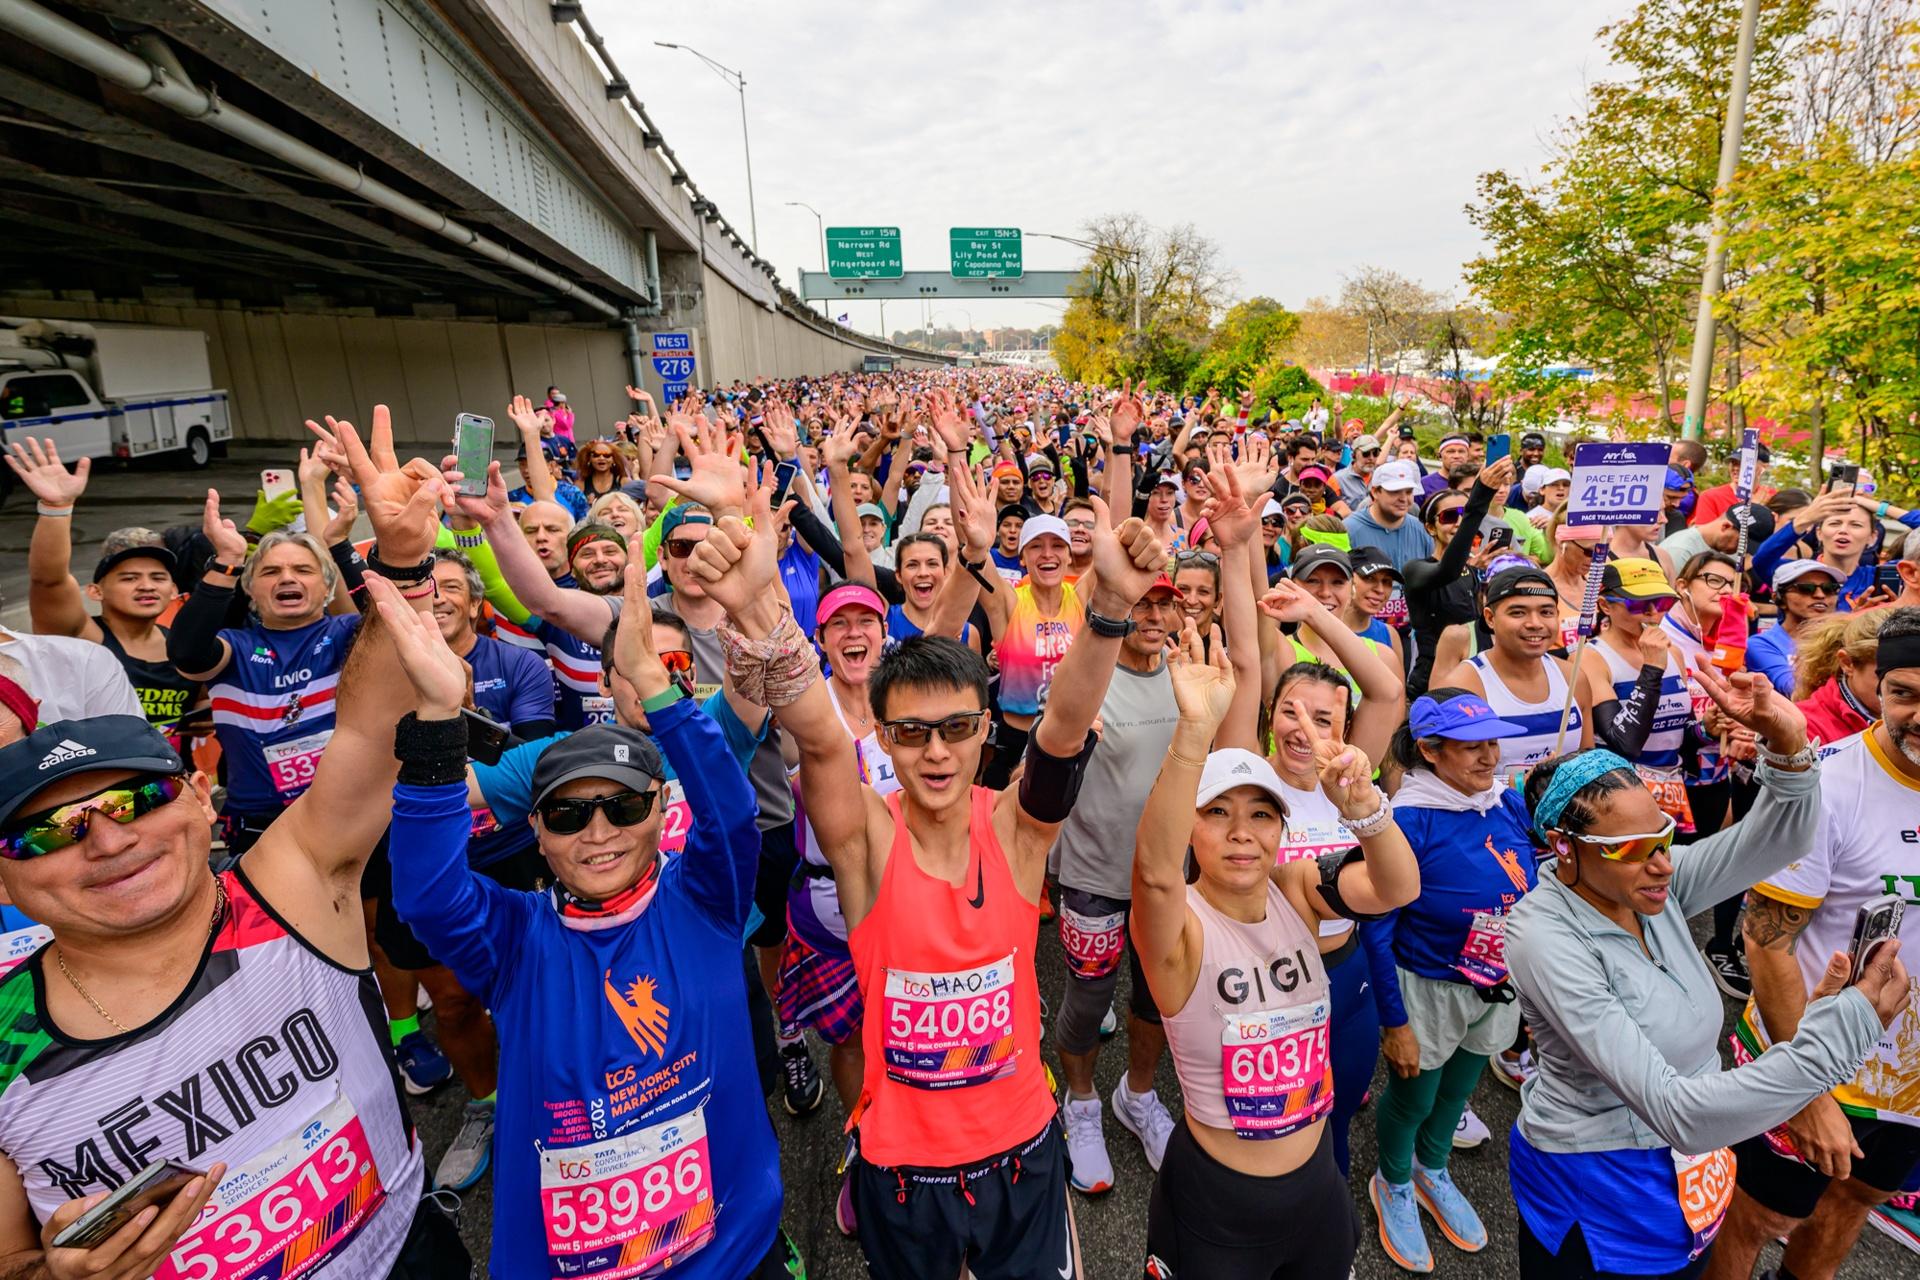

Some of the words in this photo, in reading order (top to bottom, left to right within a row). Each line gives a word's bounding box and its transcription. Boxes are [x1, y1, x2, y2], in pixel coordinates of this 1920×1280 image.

[955, 252, 971, 260] Lily
[971, 242, 987, 250] Bay
[831, 260, 885, 268] Fingerboard
[964, 261, 1001, 269] Capodanno
[656, 336, 686, 347] WEST
[661, 359, 691, 375] 278
[1586, 475, 1615, 483] PACE
[1619, 474, 1649, 482] TEAM
[1580, 485, 1648, 506] 4:50
[275, 668, 312, 688] LIVIO
[135, 688, 189, 702] EDRO
[142, 702, 182, 716] RMS
[38, 748, 96, 770] adidas
[1501, 893, 1516, 904] tcs
[1063, 921, 1119, 955] 53795
[8, 944, 36, 956] TATA
[931, 973, 982, 996] HAO
[984, 980, 1000, 990] TATA
[1217, 949, 1312, 1004] GIGI
[904, 977, 929, 997] tcs
[891, 990, 1010, 1039] 54068
[1312, 1016, 1326, 1024] TATA
[1240, 1023, 1267, 1039] tcs
[889, 1039, 906, 1048] WAVE
[908, 1041, 914, 1051] 5
[934, 1041, 960, 1049] CORRAL
[961, 1038, 969, 1046] A
[1232, 1029, 1326, 1083] 60375
[606, 1065, 636, 1089] tcs
[609, 1083, 638, 1104] NEW
[639, 1067, 671, 1090] YORK
[672, 1051, 696, 1072] CITY
[904, 1070, 964, 1079] #TCSNYCMarathon
[981, 1062, 997, 1073] 2023
[1248, 1086, 1255, 1094] 5
[1298, 1078, 1304, 1087] D
[37, 1008, 340, 1200] MÉXICO
[611, 1075, 680, 1118] MARATHON
[641, 1110, 654, 1120] NEW
[655, 1102, 670, 1112] YORK
[671, 1094, 687, 1105] ROAD
[591, 1098, 607, 1139] 2023
[304, 1128, 331, 1151] TATA
[659, 1137, 683, 1153] TATA
[594, 1149, 616, 1159] TATA
[594, 1146, 646, 1167] CONSULTANCY
[222, 1154, 288, 1200] CONSULTANCY
[559, 1159, 590, 1179] tcs
[595, 1161, 628, 1175] SERVICES
[218, 1173, 248, 1193] TATA
[224, 1176, 269, 1207] SERVICES
[552, 1148, 702, 1238] 53986
[170, 1136, 356, 1280] 53613
[341, 1210, 364, 1234] 2023
[552, 1242, 571, 1250] WAVE
[573, 1240, 580, 1252] 5
[584, 1239, 603, 1249] PINK
[604, 1229, 638, 1243] CORRAL
[639, 1221, 650, 1232] A
[229, 1260, 256, 1280] PINK
[258, 1230, 300, 1262] CORRAL
[301, 1217, 315, 1232] A
[283, 1252, 320, 1280] arathon
[664, 1257, 672, 1269] B
